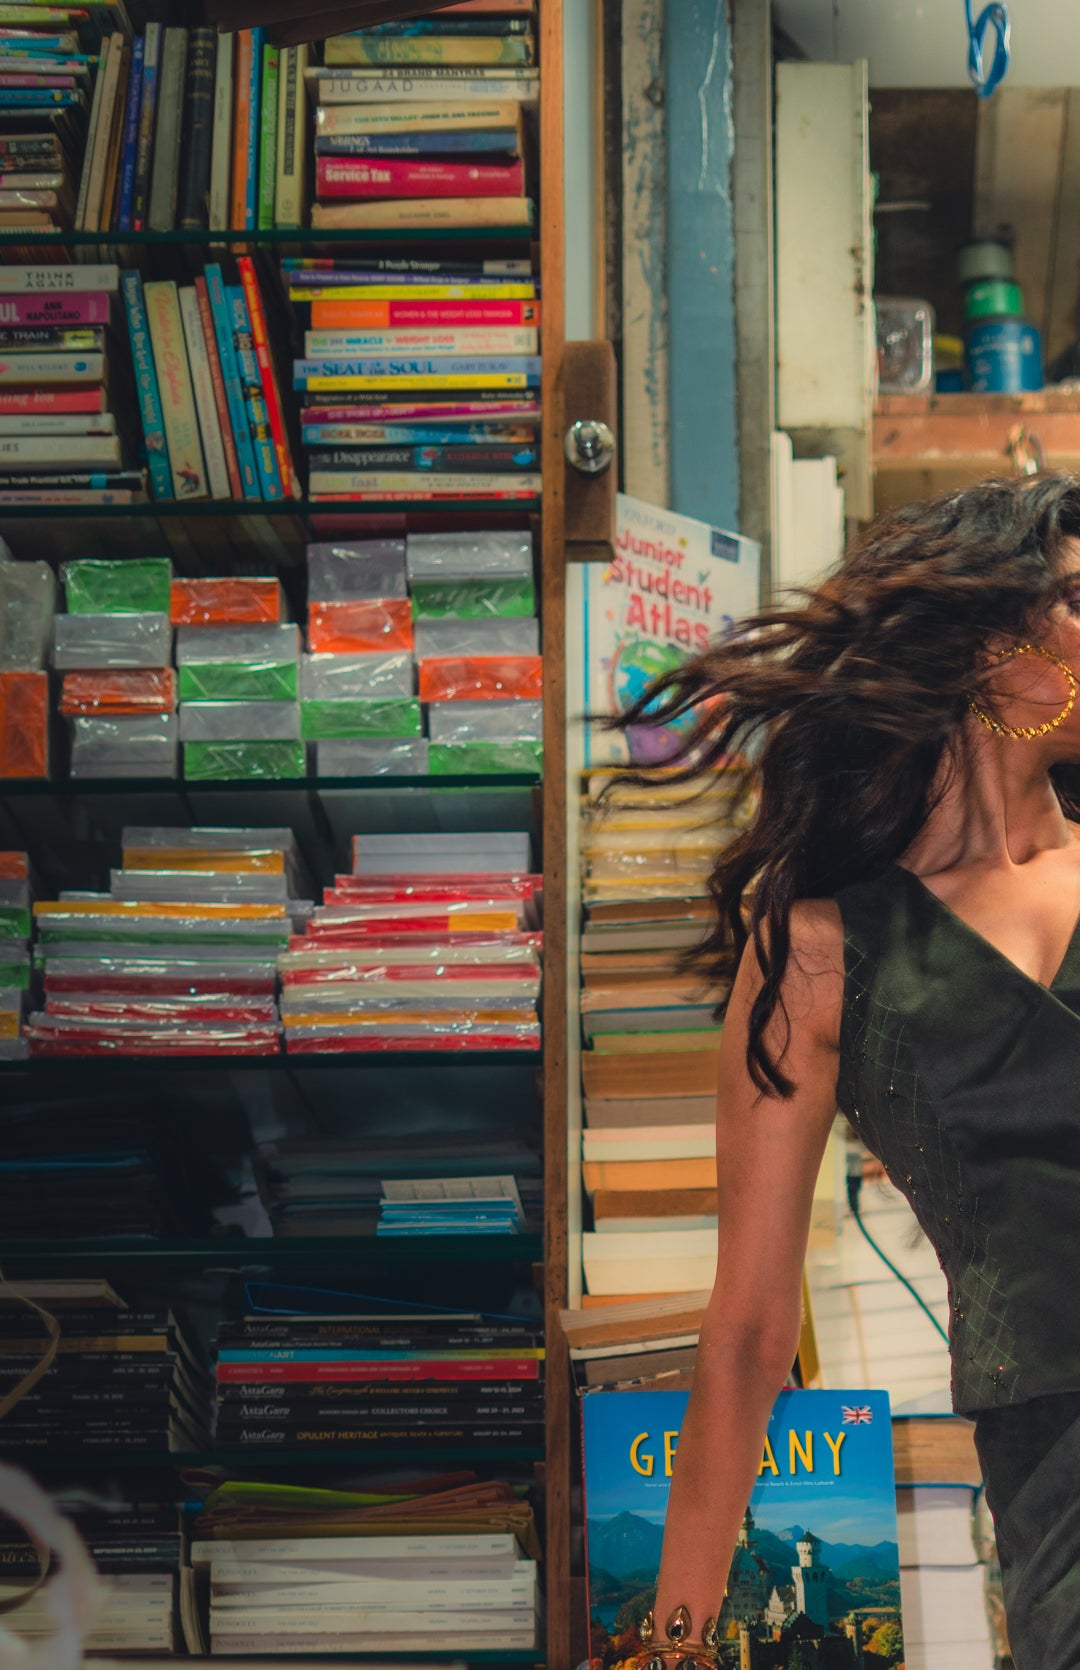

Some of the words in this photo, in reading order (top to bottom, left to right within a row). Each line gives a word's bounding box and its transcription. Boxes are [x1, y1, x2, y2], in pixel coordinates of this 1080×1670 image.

[397, 69, 433, 77] BRAND
[436, 69, 485, 77] MANTRAS
[328, 80, 414, 93] JUGAAD
[325, 169, 369, 183] Service
[371, 170, 391, 183] Tax
[24, 271, 74, 280] THINK
[24, 279, 75, 289] AGAIN
[43, 301, 63, 311] ANN
[26, 311, 81, 322] NAPOLITANO
[233, 298, 248, 329] NICK
[13, 330, 50, 341] TRAIN
[345, 336, 383, 345] MIRACLE
[395, 335, 431, 344] WEIGHT
[303, 366, 318, 374] THE
[322, 361, 365, 376] SEAT
[389, 360, 437, 375] SOUL
[333, 451, 410, 465] Disappearance
[615, 529, 686, 568] Junior
[609, 556, 713, 614] Student
[626, 592, 712, 650] Atlas
[318, 1326, 380, 1335] INTERNATIONAL
[239, 1385, 287, 1397] AstaGuru
[239, 1404, 291, 1418] AstaGuru
[420, 1406, 449, 1415] CHOICE
[239, 1428, 287, 1442] AstaGuru
[296, 1431, 336, 1440] OPULENT
[337, 1431, 379, 1440] HERITAGE
[629, 1428, 847, 1479] GEANY
